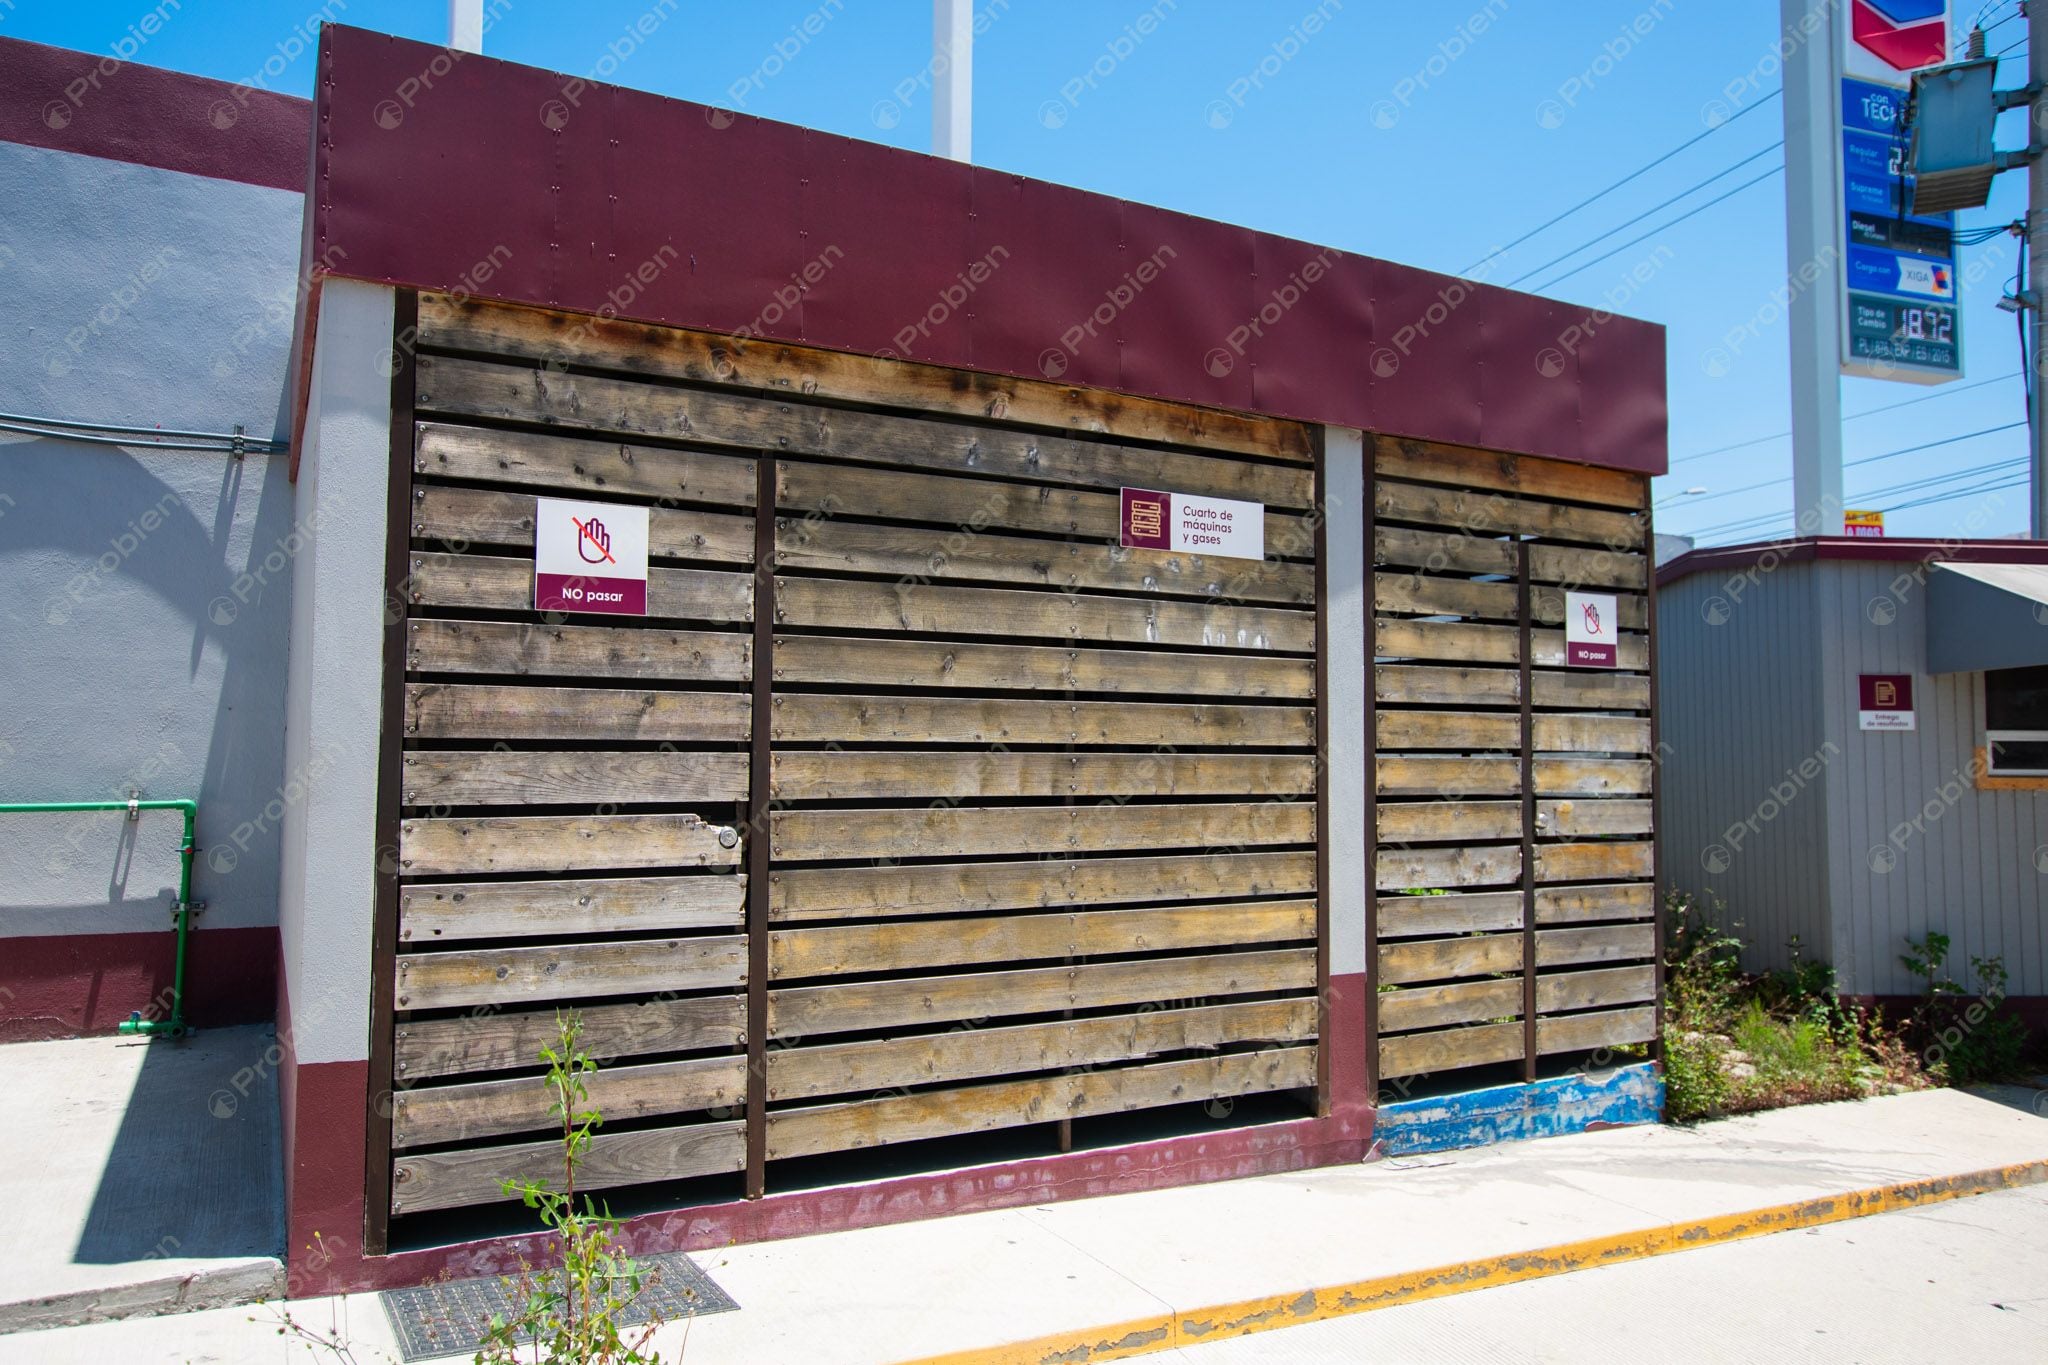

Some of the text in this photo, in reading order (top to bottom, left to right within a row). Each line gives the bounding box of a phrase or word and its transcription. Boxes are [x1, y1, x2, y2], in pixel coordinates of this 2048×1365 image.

[1870, 93, 1888, 104] con
[1849, 144, 1878, 158] Regular
[1850, 181, 1883, 196] Supreme
[1852, 220, 1875, 232] Diesel
[1905, 270, 1930, 282] XIGA
[1858, 306, 1874, 317] Tipo
[1876, 309, 1885, 318] de
[1858, 316, 1887, 328] Cambio
[1183, 505, 1233, 521] Cuarto de
[1183, 519, 1232, 533] máquinas
[1182, 533, 1221, 545] y gases
[562, 588, 623, 603] NO pasar
[1578, 651, 1606, 660] NO pasar
